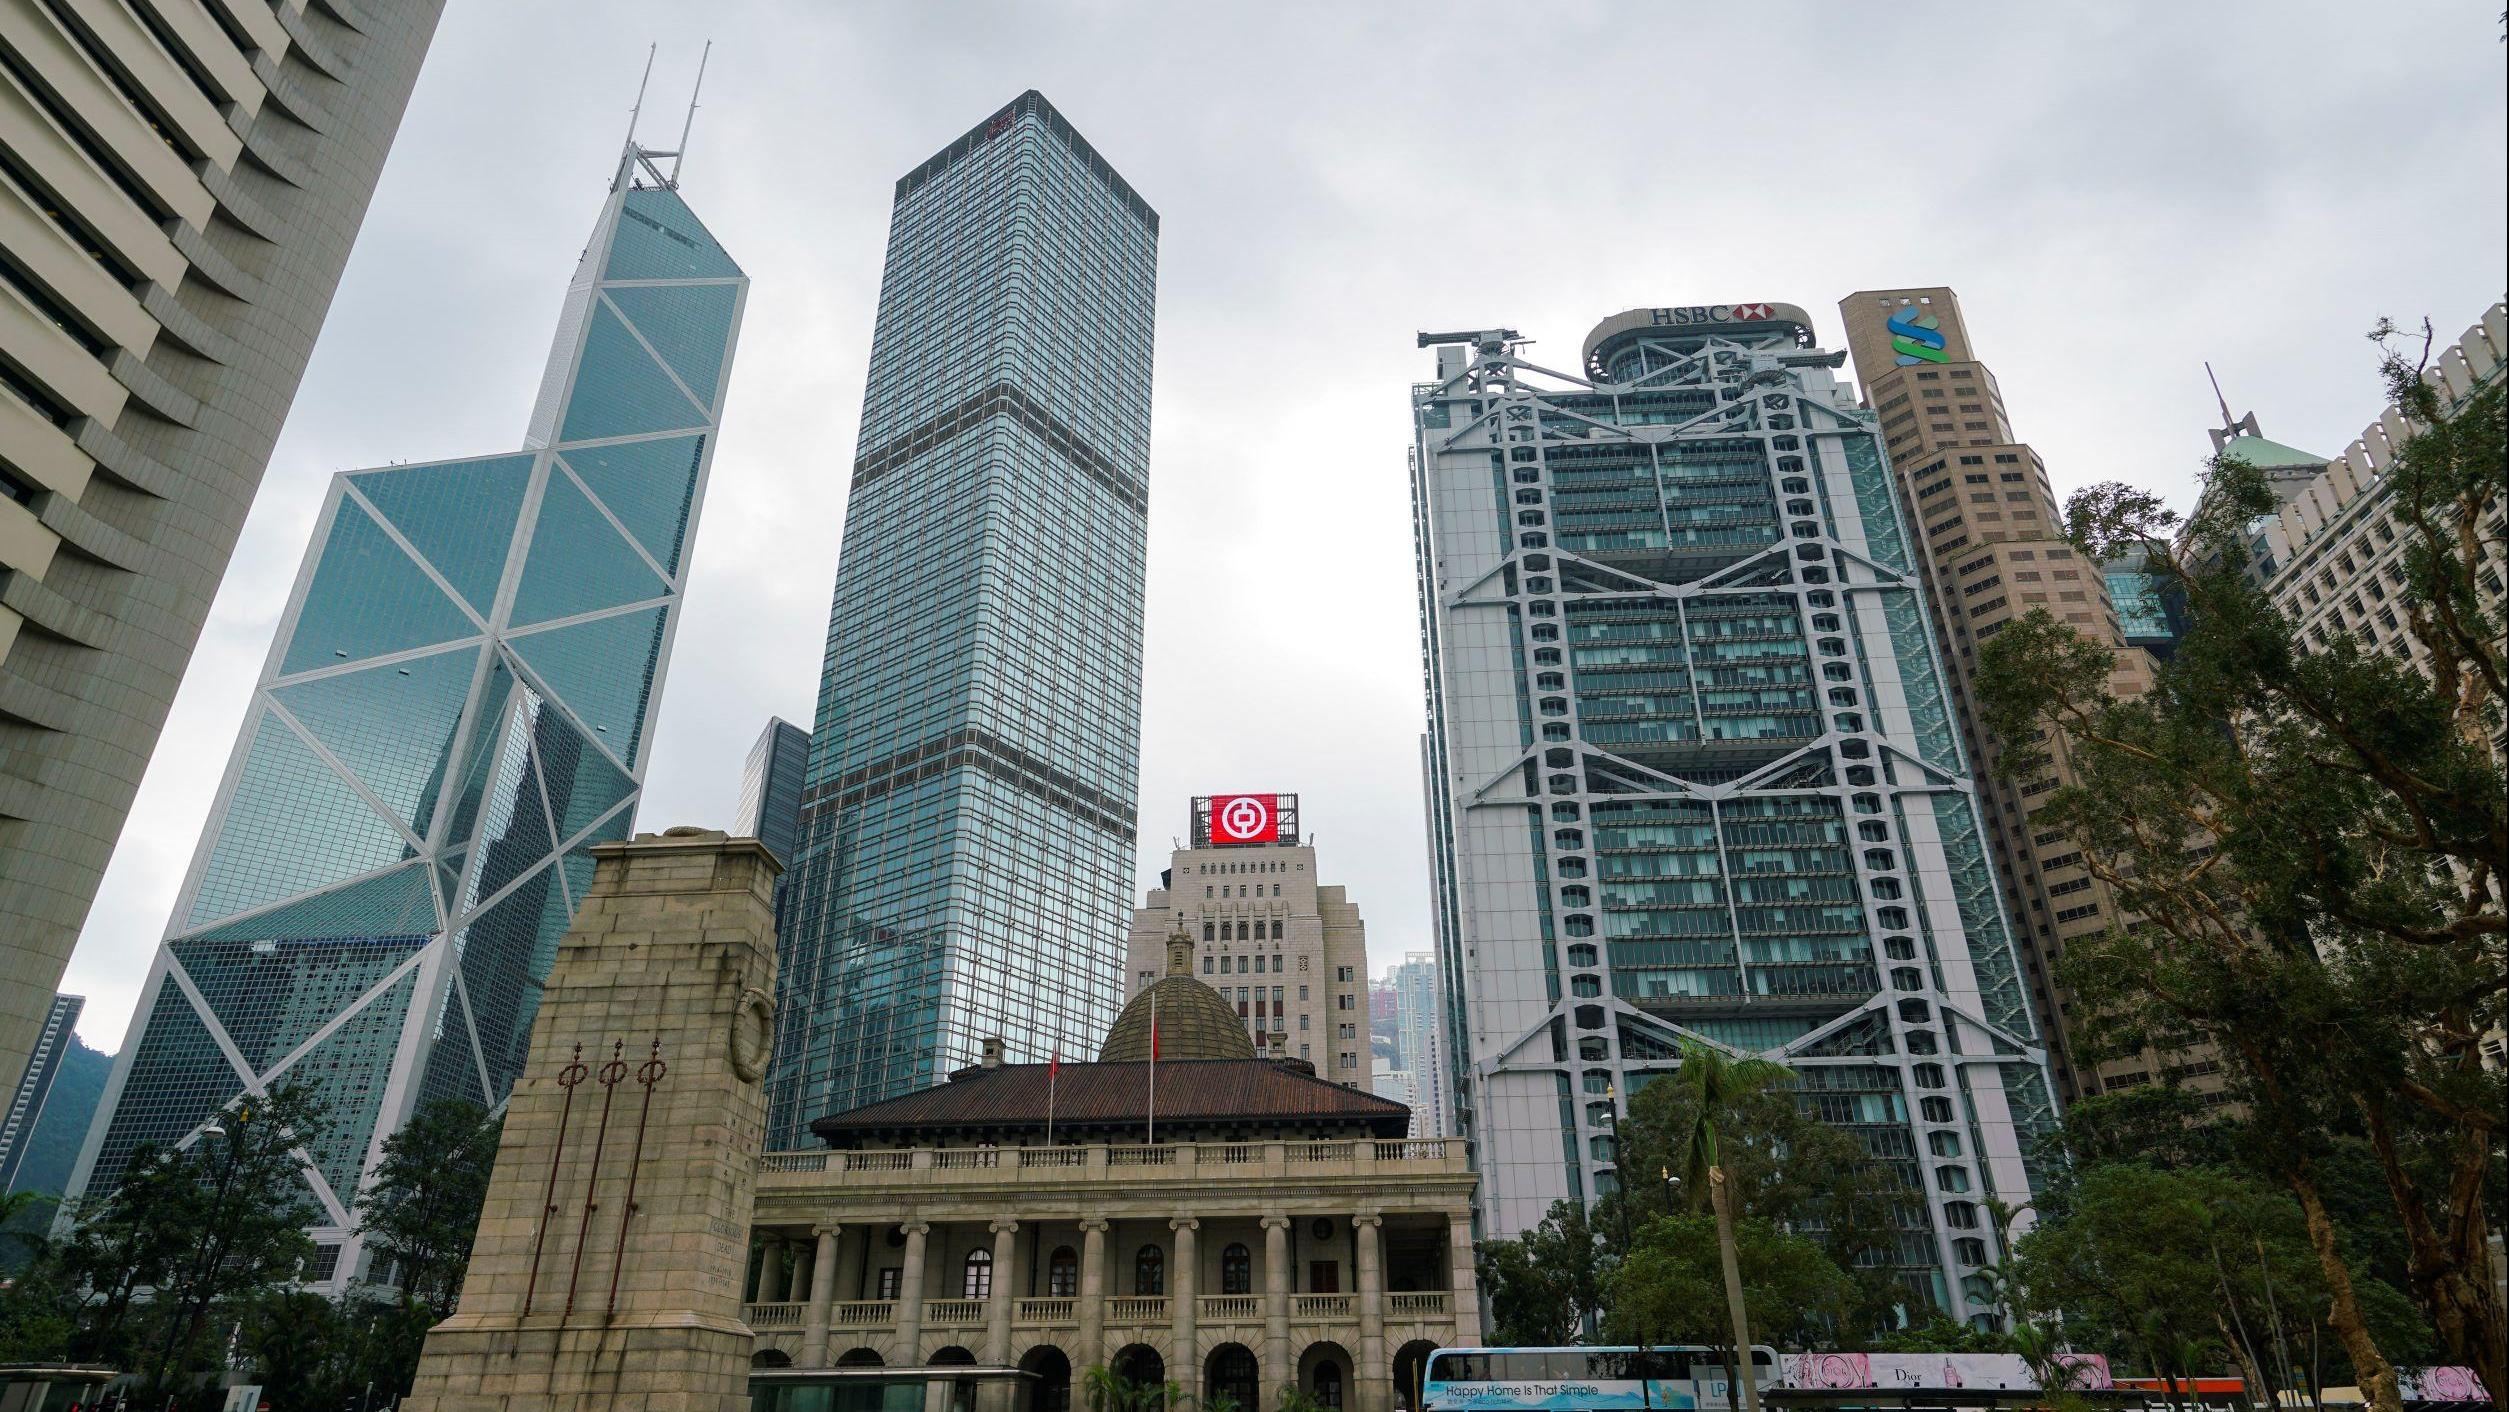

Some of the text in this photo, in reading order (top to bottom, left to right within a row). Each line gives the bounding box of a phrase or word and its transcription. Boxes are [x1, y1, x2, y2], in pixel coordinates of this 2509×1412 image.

[1650, 304, 1731, 326] HSBC
[725, 1207, 736, 1220] THE
[717, 1241, 732, 1255] DEAD
[1895, 1368, 1922, 1381] Dior
[1446, 1385, 1483, 1398] Happy
[1487, 1385, 1520, 1396] Home
[1524, 1385, 1532, 1396] Is
[1533, 1384, 1558, 1396] That
[1559, 1384, 1598, 1397] Simple
